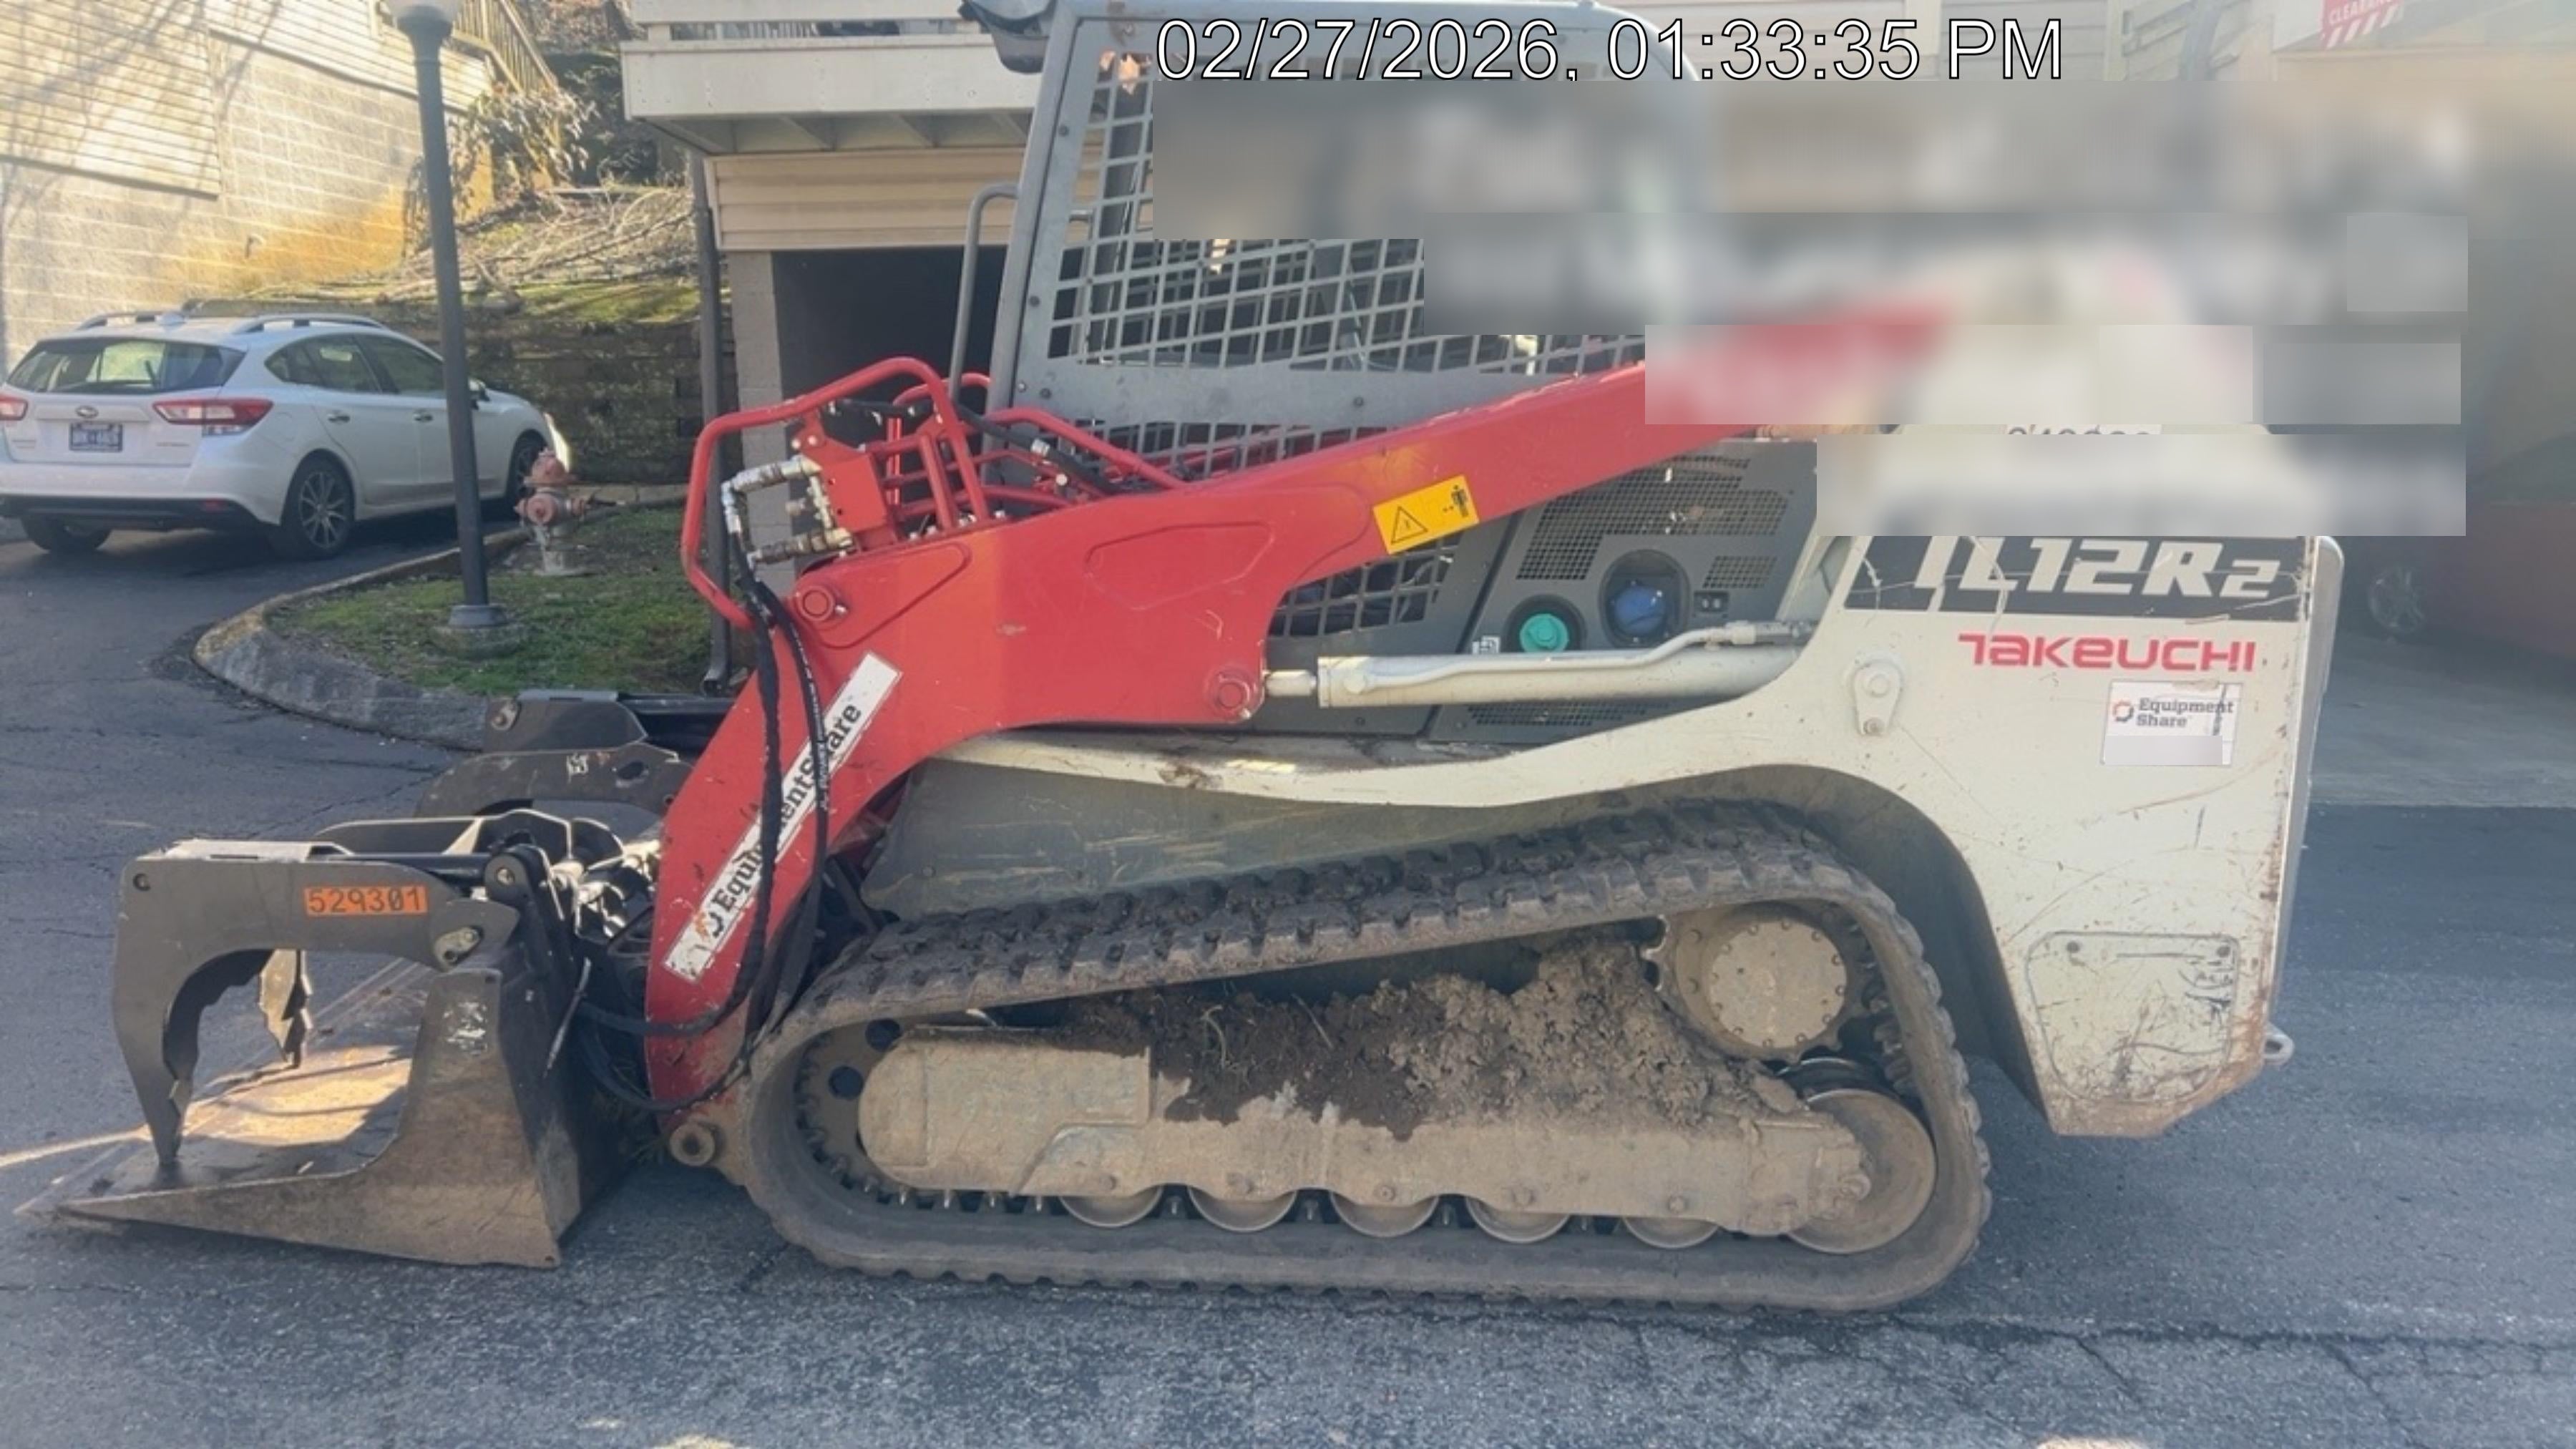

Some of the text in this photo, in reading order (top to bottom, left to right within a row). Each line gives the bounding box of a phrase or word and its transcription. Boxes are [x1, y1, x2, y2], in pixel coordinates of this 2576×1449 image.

[2137, 697, 2235, 713] Equipment
[2136, 713, 2188, 728] Share
[711, 705, 862, 912] EquientSare
[308, 886, 421, 914] 529301
